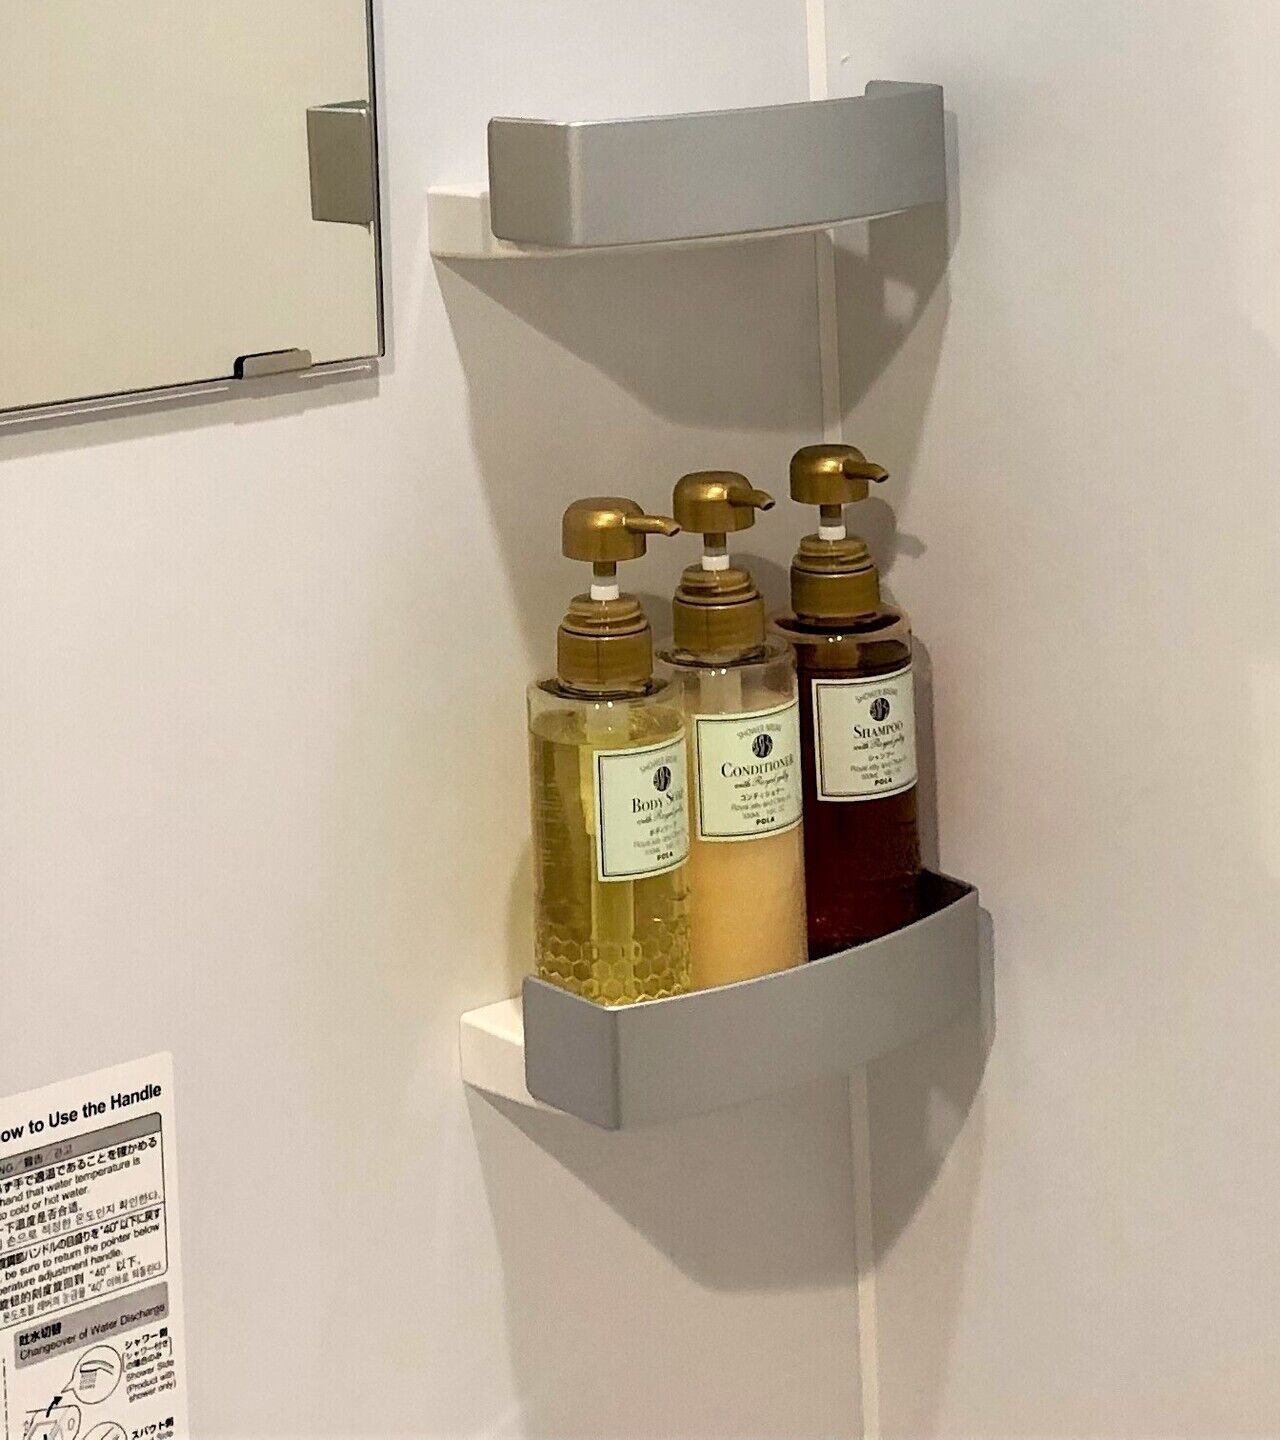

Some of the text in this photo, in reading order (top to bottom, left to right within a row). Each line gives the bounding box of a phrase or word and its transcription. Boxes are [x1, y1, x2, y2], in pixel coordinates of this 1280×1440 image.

[853, 721, 904, 739] SHAMPOO
[874, 777, 893, 786] POLA
[756, 816, 775, 826] POLA
[28, 1120, 45, 1134] to
[48, 1109, 78, 1128] Use
[82, 1101, 107, 1118] the
[110, 1083, 162, 1110] Handle
[0, 1191, 24, 1207] hand
[25, 1185, 45, 1200] that
[45, 1177, 73, 1192] water
[74, 1160, 131, 1185] temperature
[132, 1157, 141, 1166] is
[9, 1203, 30, 1218] cold
[31, 1200, 42, 1211] or
[44, 1194, 60, 1206] hot
[4, 1270, 18, 1281] be
[19, 1262, 41, 1277] sure
[42, 1258, 53, 1269] to
[54, 1249, 82, 1265] return
[83, 1244, 99, 1255] the
[100, 1232, 131, 1252] pointer
[133, 1223, 160, 1239] below
[37, 1258, 89, 1283] adjustment
[19, 1303, 166, 1361] Changeover of Water Discharge
